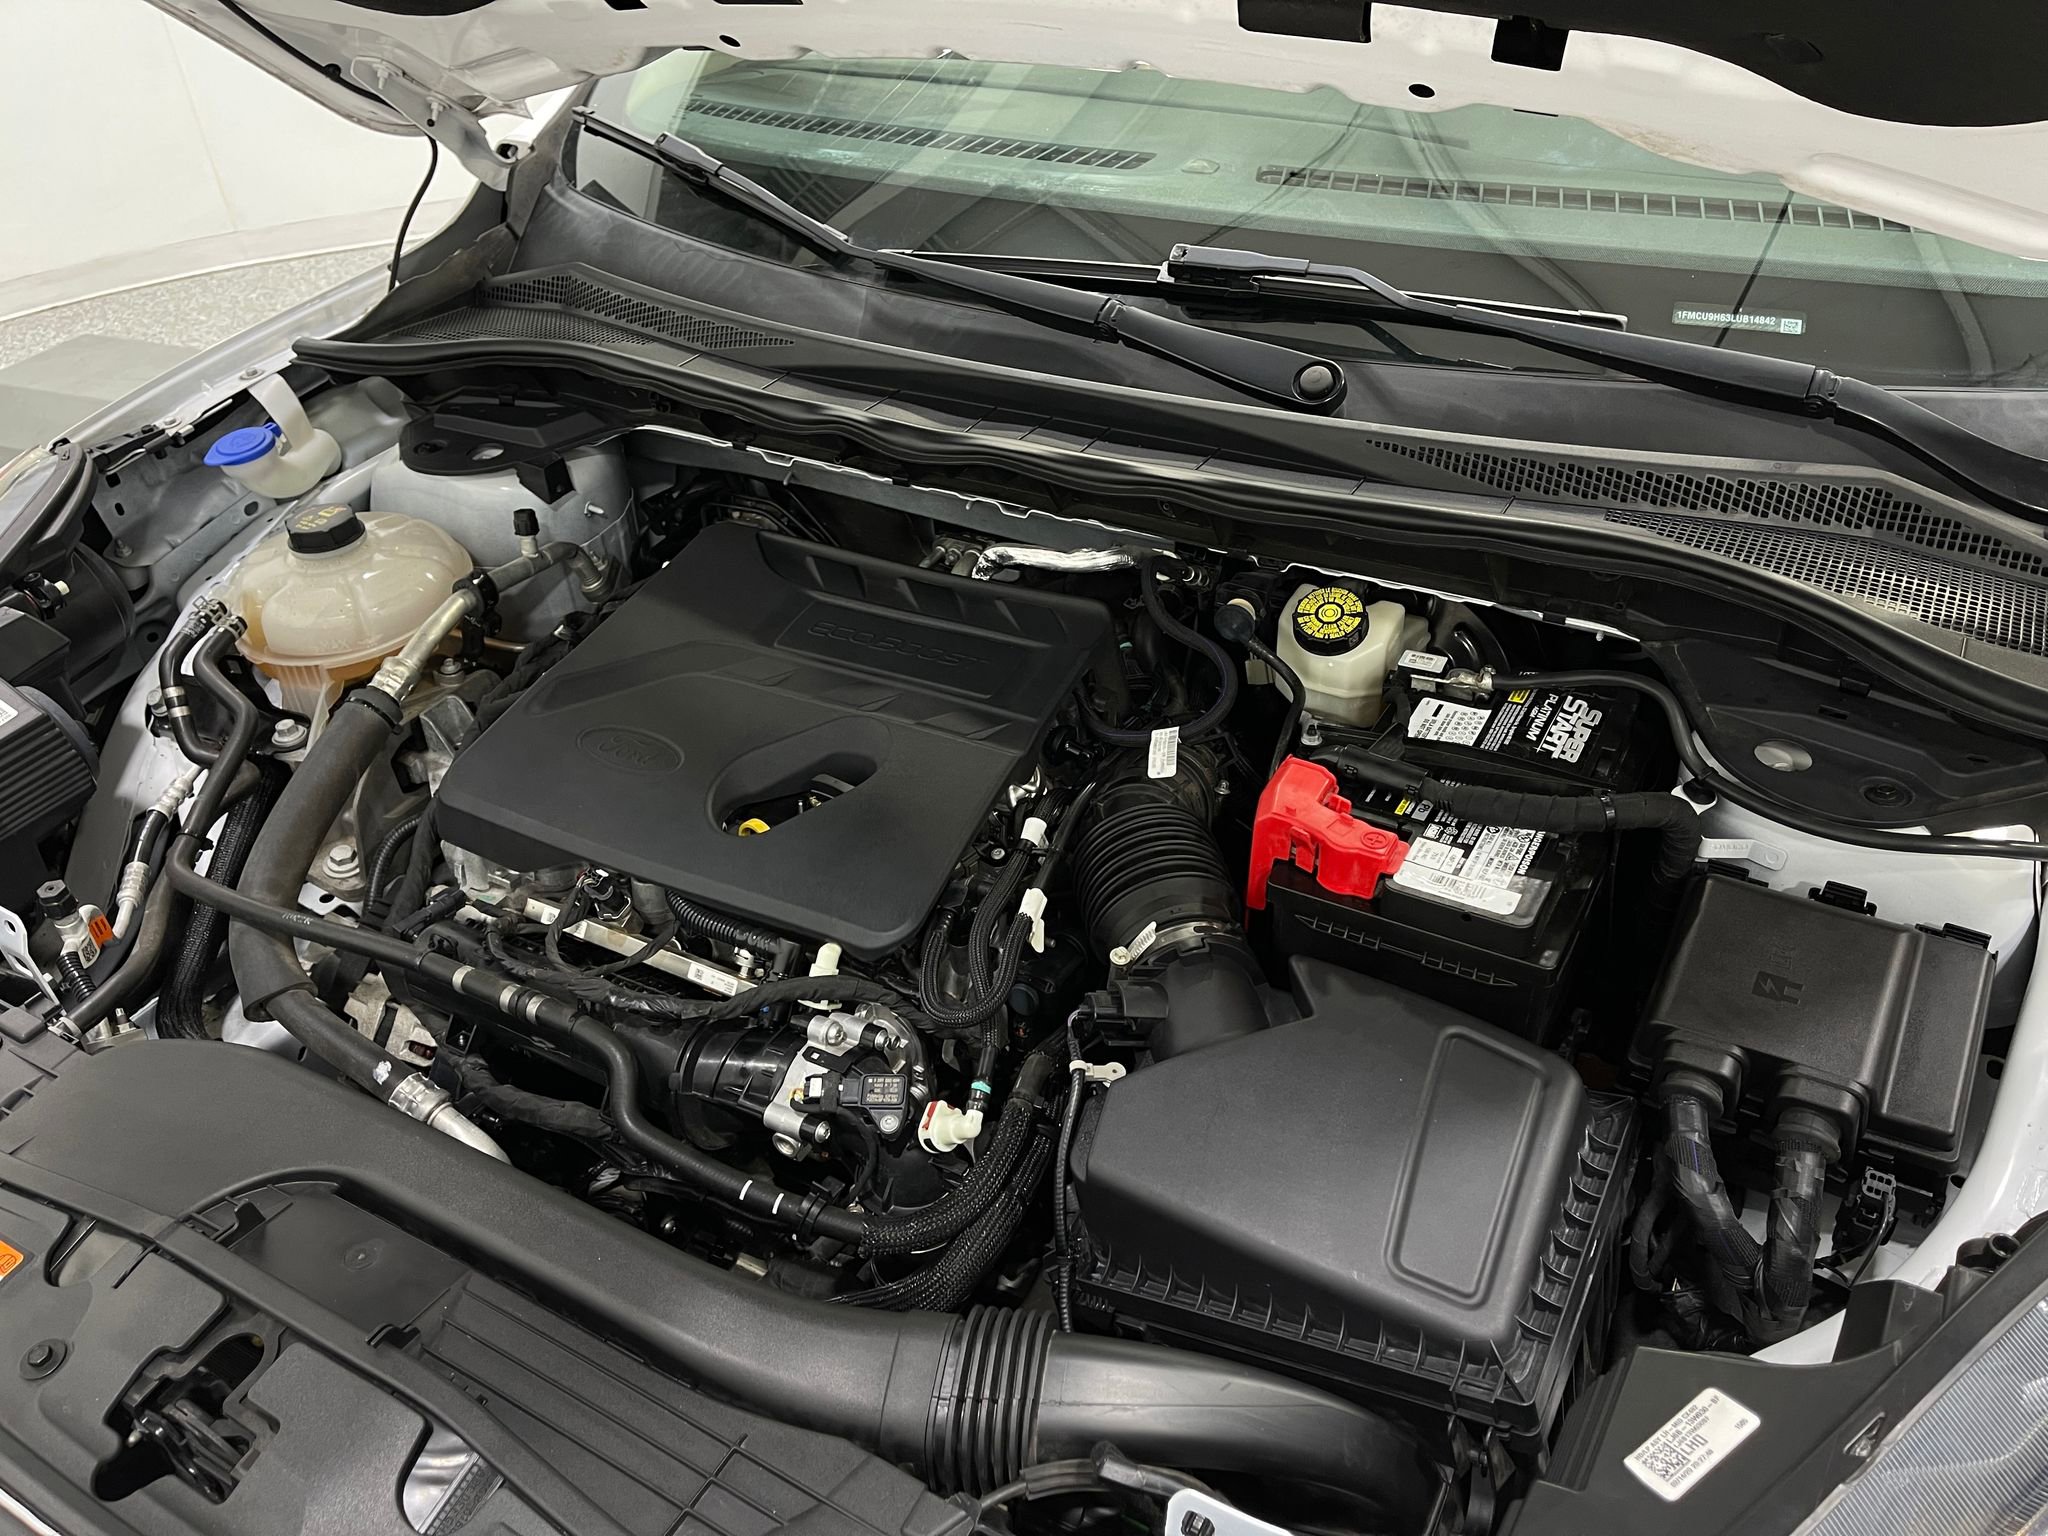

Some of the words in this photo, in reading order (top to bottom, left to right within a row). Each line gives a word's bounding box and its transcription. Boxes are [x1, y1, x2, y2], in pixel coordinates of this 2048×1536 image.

[1676, 310, 1776, 325] 1FMCU9H63LUB14842
[1525, 693, 1560, 742] PLATINUM
[1542, 695, 1588, 759] START
[1559, 707, 1603, 763] SUPER
